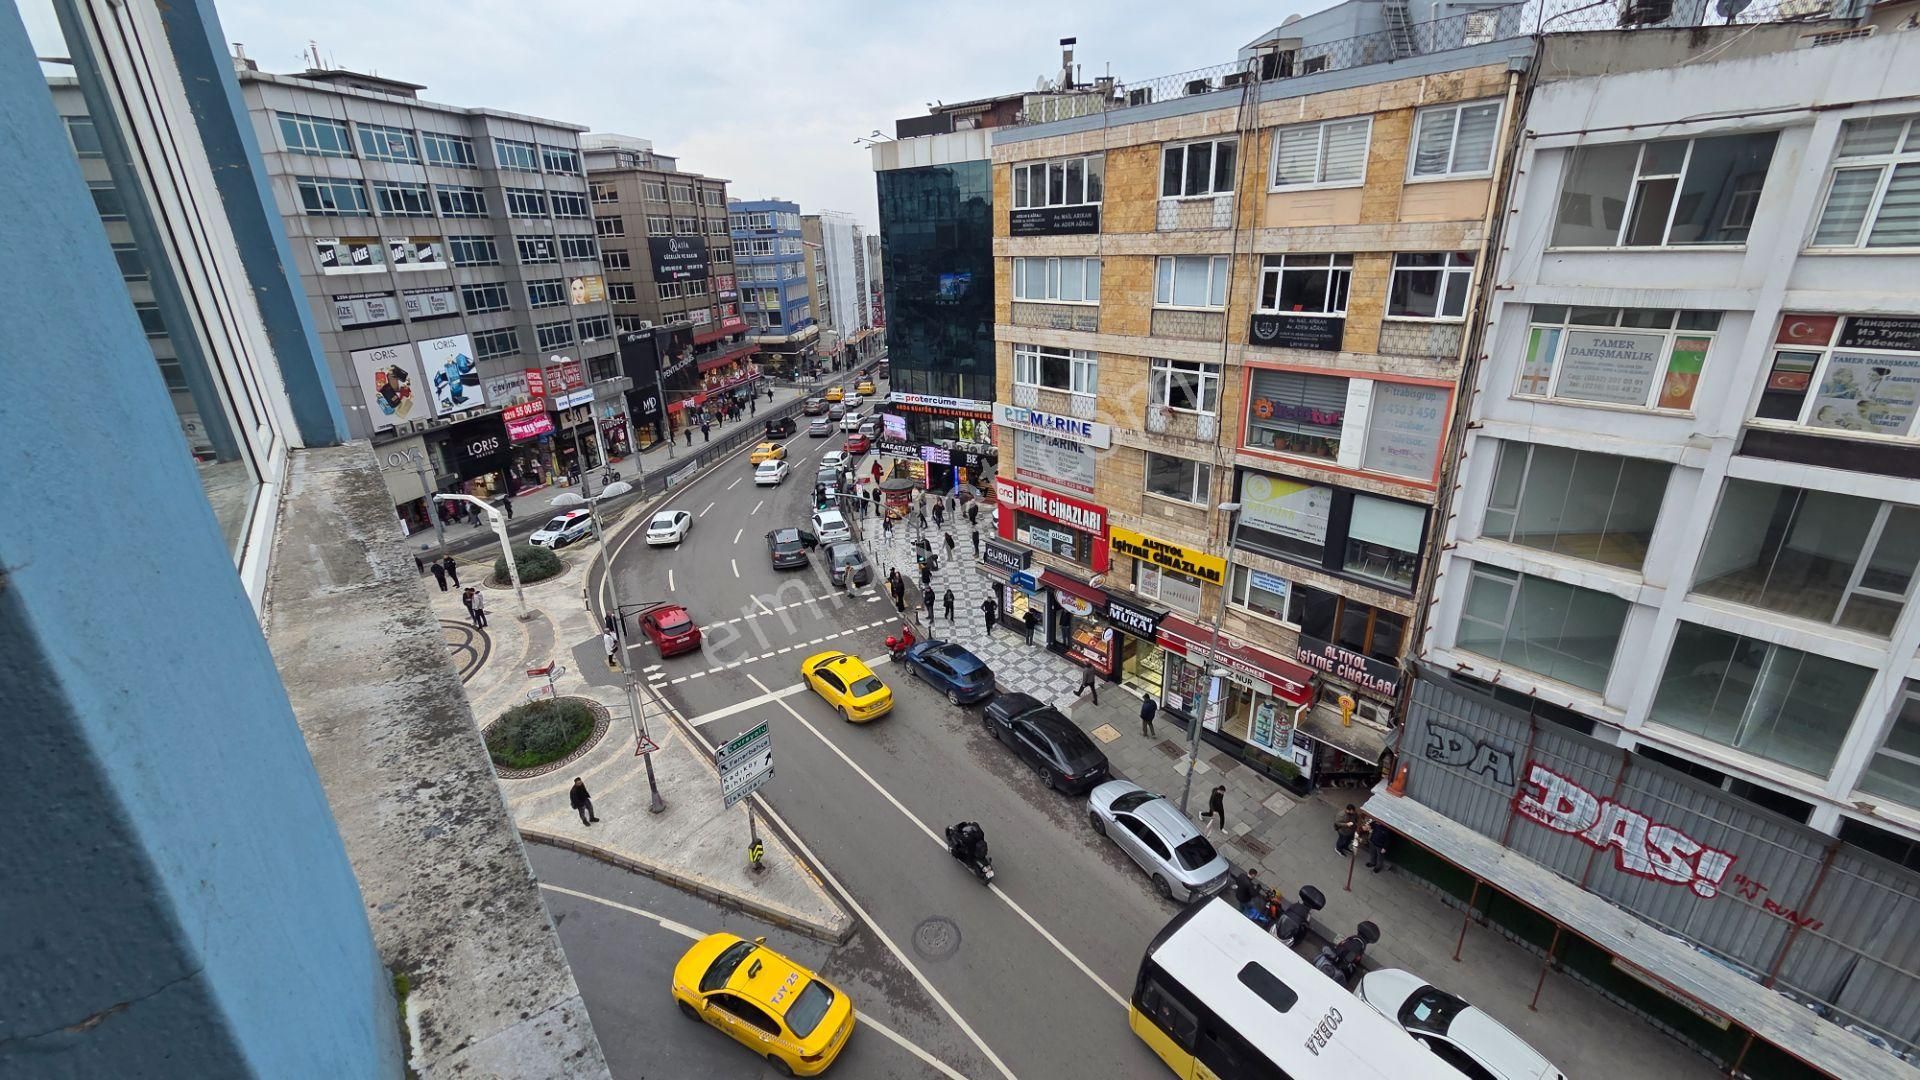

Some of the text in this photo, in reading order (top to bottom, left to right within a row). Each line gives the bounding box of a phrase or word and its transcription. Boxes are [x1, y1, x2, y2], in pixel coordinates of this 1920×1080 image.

[1570, 347, 1654, 361] DANIŞMANLIK
[1593, 339, 1635, 349] TAMER
[1833, 356, 1865, 365] TAMER
[905, 395, 957, 407] protercüme
[880, 442, 917, 454] KARATEKİN
[1048, 498, 1101, 531] CİHAZLARI
[1142, 538, 1184, 558] ALTIYOL
[1153, 551, 1220, 582] CİHAZLARI
[1186, 642, 1211, 657] MERKEZ
[1214, 654, 1228, 664] NUR
[1232, 661, 1265, 679] ECZANESİ
[1296, 645, 1334, 673] İŞİTME
[1337, 665, 1397, 696] CİHAZLARI
[1325, 646, 1368, 671] ALTIYOL
[1235, 675, 1253, 687] NUR
[1510, 759, 1738, 899] DAS!
[771, 972, 800, 1004] TJY 25
[1304, 1006, 1343, 1057] COBRA
